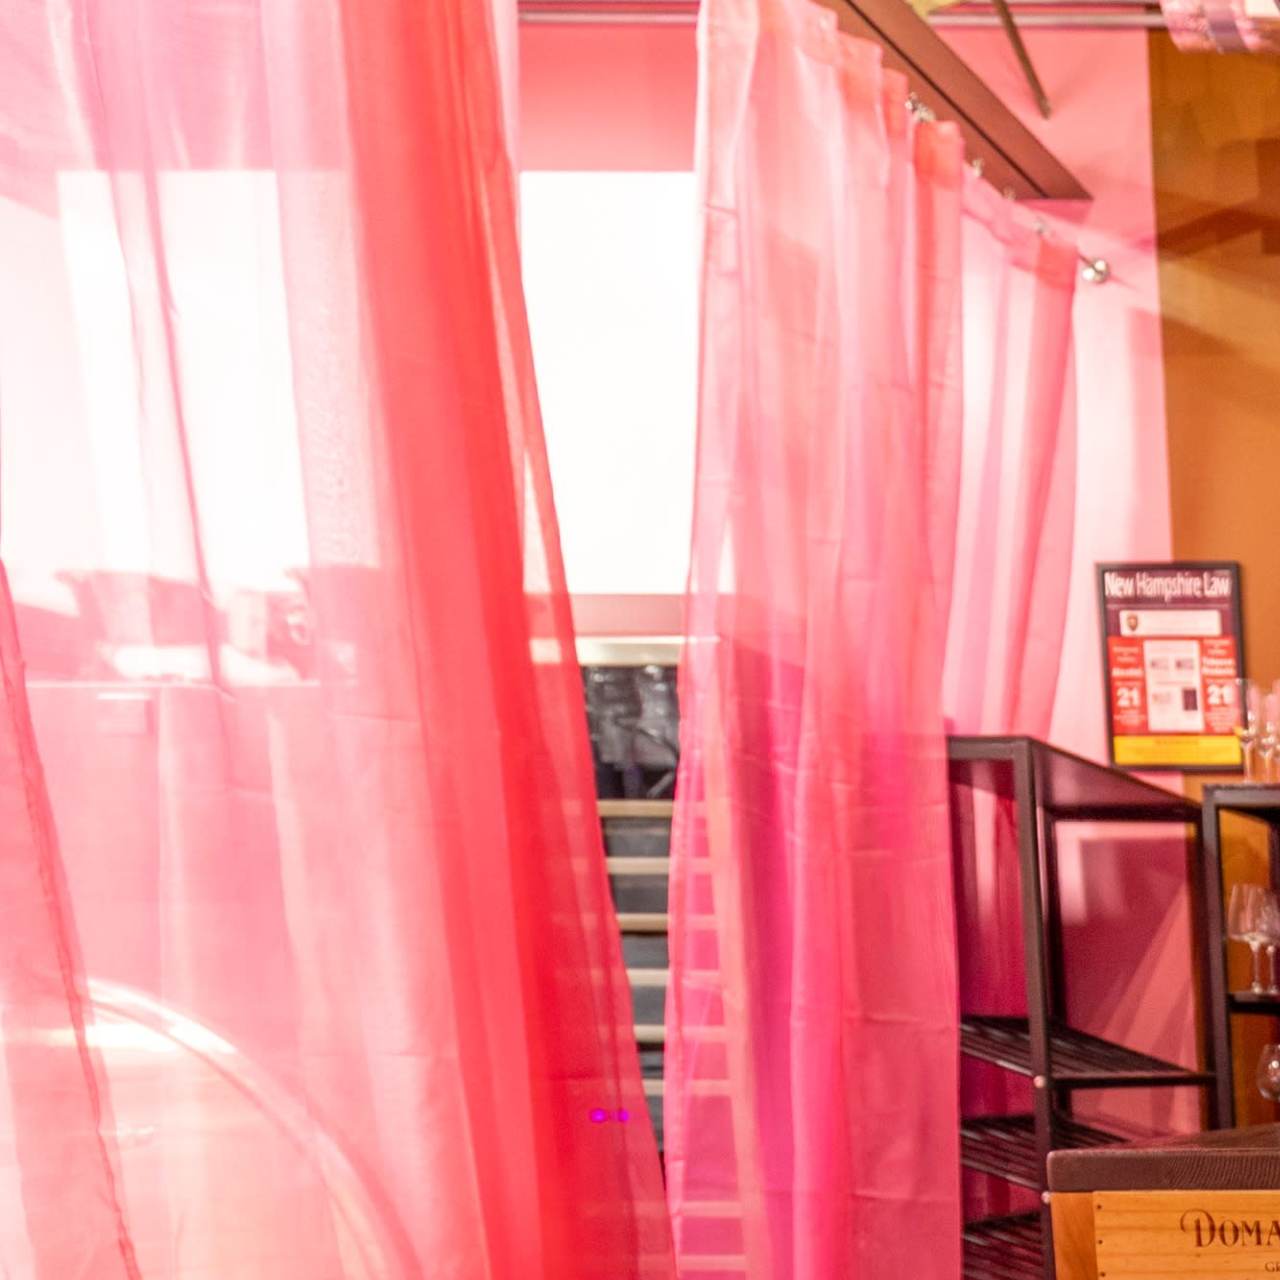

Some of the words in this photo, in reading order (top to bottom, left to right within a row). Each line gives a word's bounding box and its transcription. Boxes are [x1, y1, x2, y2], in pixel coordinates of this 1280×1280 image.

[1104, 571, 1134, 597] New
[1136, 571, 1201, 603] Hampshire
[1203, 571, 1231, 597] Law
